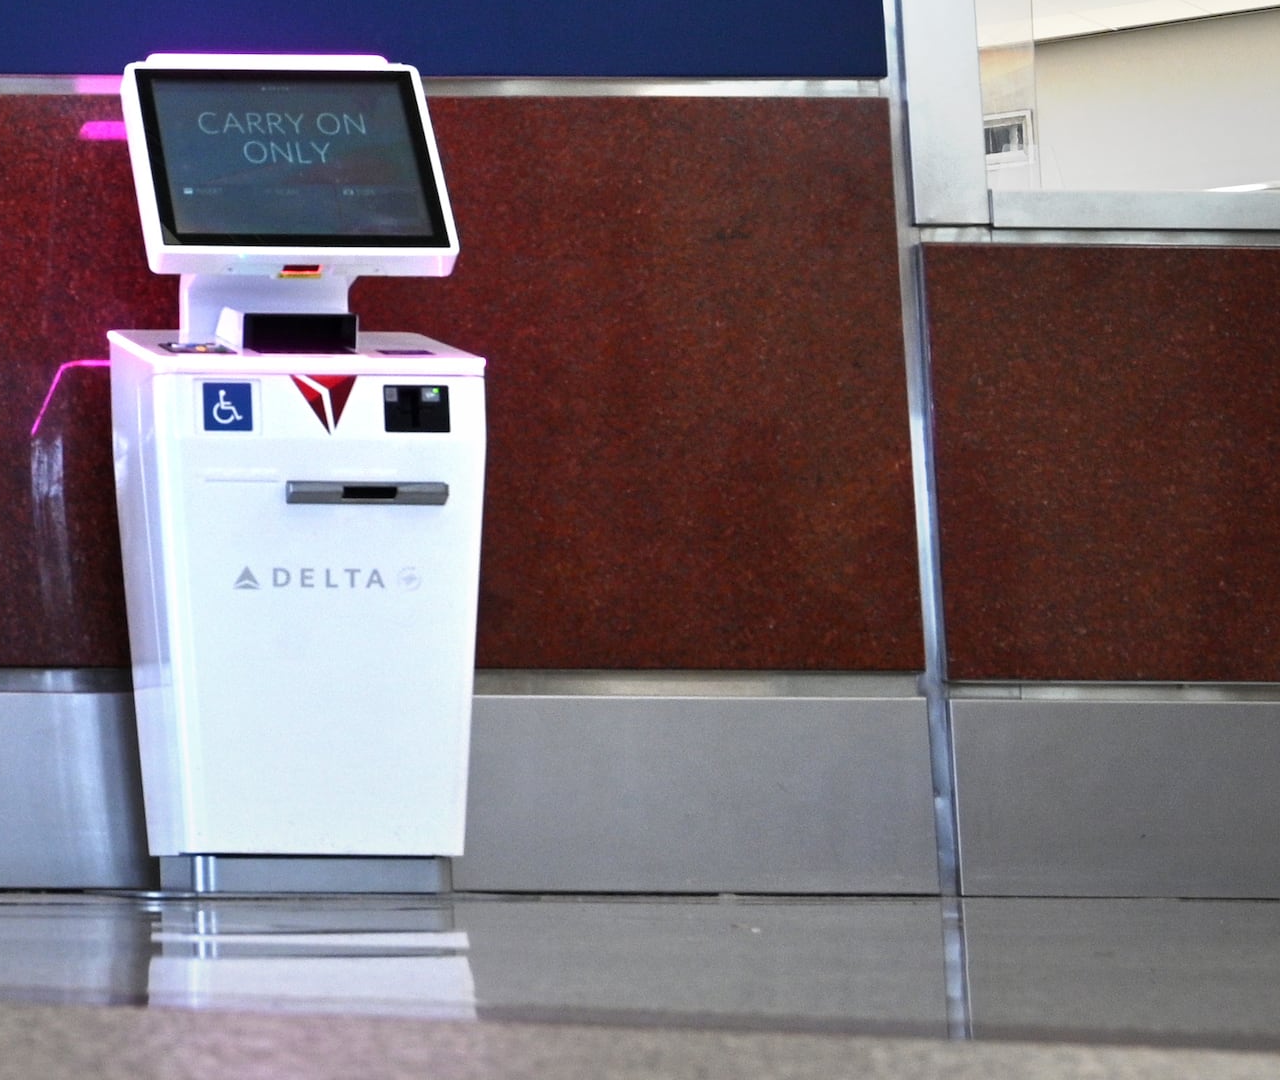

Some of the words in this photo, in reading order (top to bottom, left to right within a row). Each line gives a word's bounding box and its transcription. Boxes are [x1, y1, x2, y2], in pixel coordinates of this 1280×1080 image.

[198, 111, 304, 135] CARRY
[316, 112, 366, 135] ON
[243, 140, 330, 164] ONLY
[272, 568, 385, 589] DELTA
